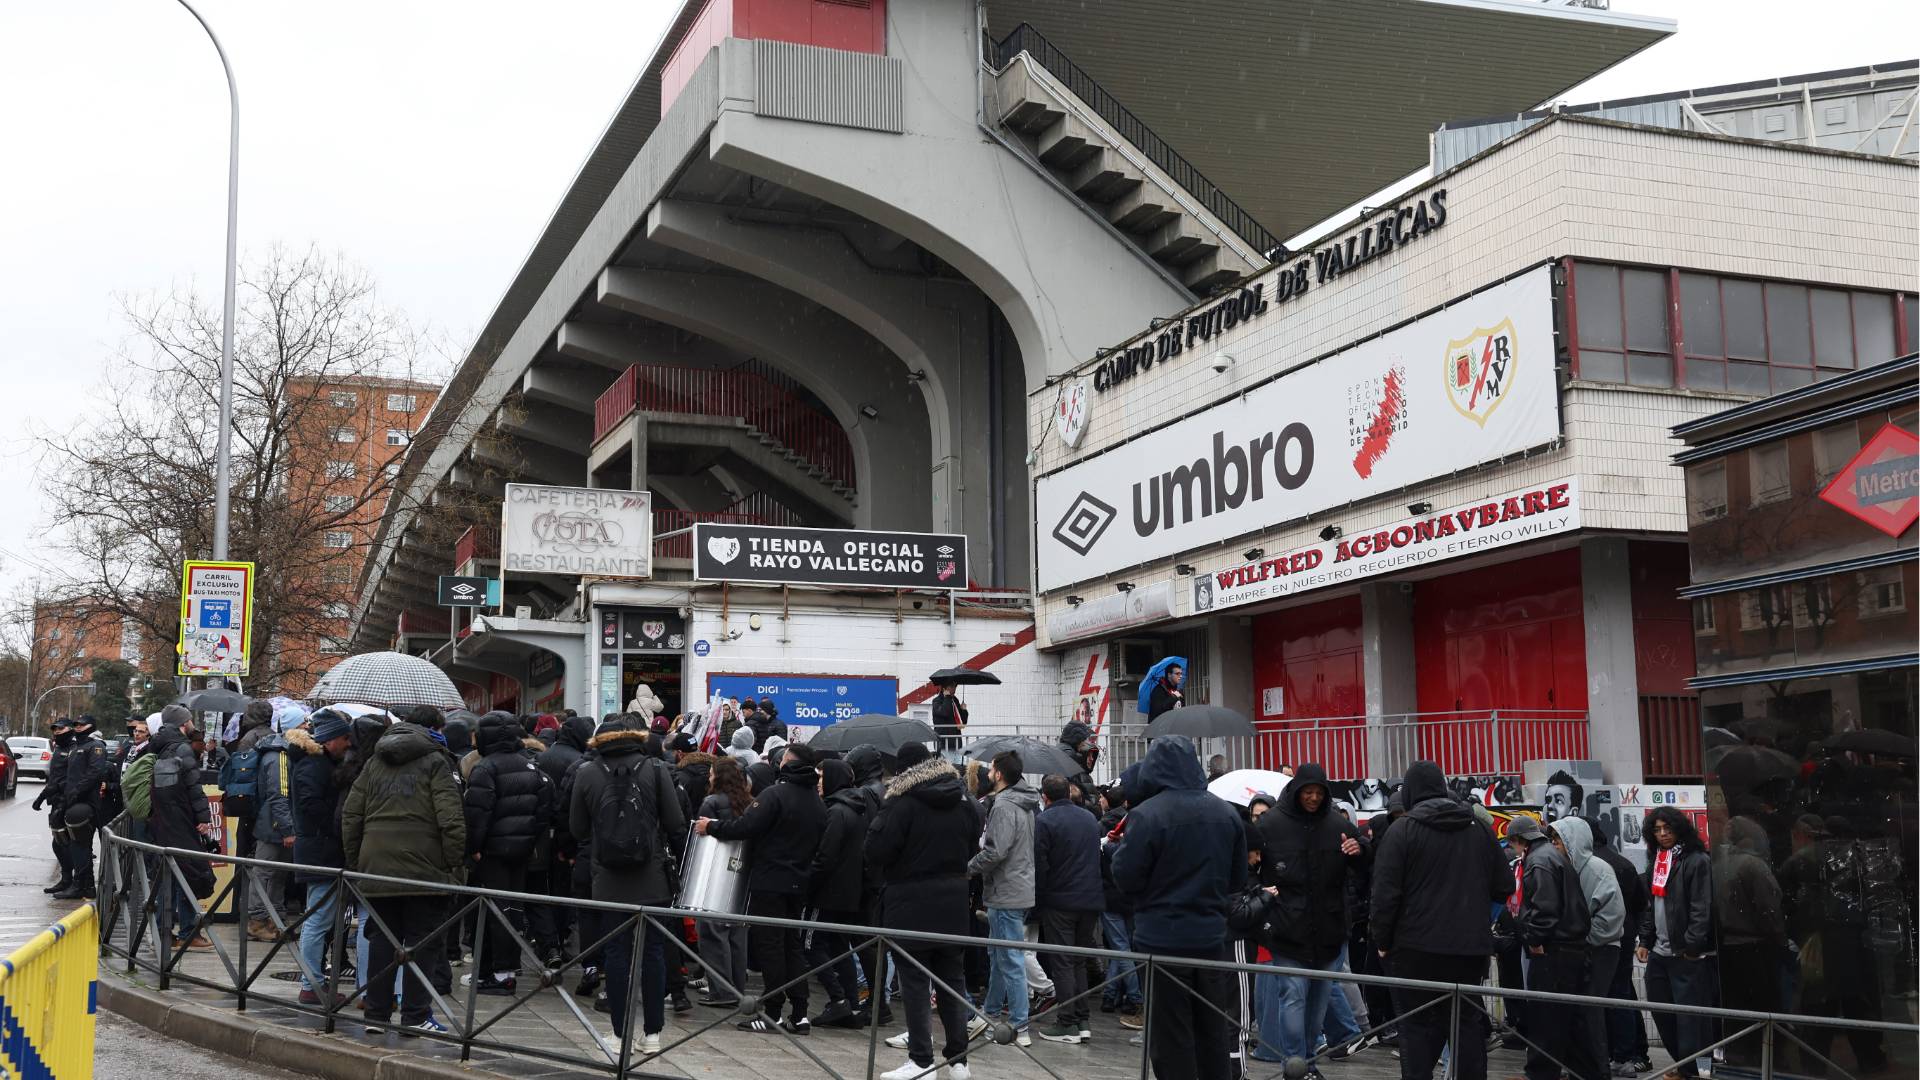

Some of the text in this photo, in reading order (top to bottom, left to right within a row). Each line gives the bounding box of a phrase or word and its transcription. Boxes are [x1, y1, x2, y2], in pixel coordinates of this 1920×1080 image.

[1094, 189, 1447, 392] CAMPO DE FUTBOL DE VALLECAS
[1348, 399, 1380, 416] OFICIAL
[1349, 410, 1407, 436] VALLECANO
[1350, 420, 1408, 447] DE MADRID
[1132, 421, 1315, 538] umbro
[1860, 468, 1919, 498] Metro
[509, 488, 617, 509] CAFETERIA
[748, 537, 924, 557] TIENDA OFICIAL
[1216, 483, 1570, 591] WILFRED AGBONAVBARE
[507, 553, 647, 575] RESTAURANTE
[750, 554, 802, 569] RAYO
[808, 556, 924, 573] VALLECANO
[1219, 516, 1569, 605] SIEMPRE EN NUESTRO RECUERDO ETERNO WILLY
[1195, 576, 1211, 585] PUERTA
[757, 686, 778, 694] DIGI
[795, 707, 819, 718] 500
[836, 708, 851, 718] 50
